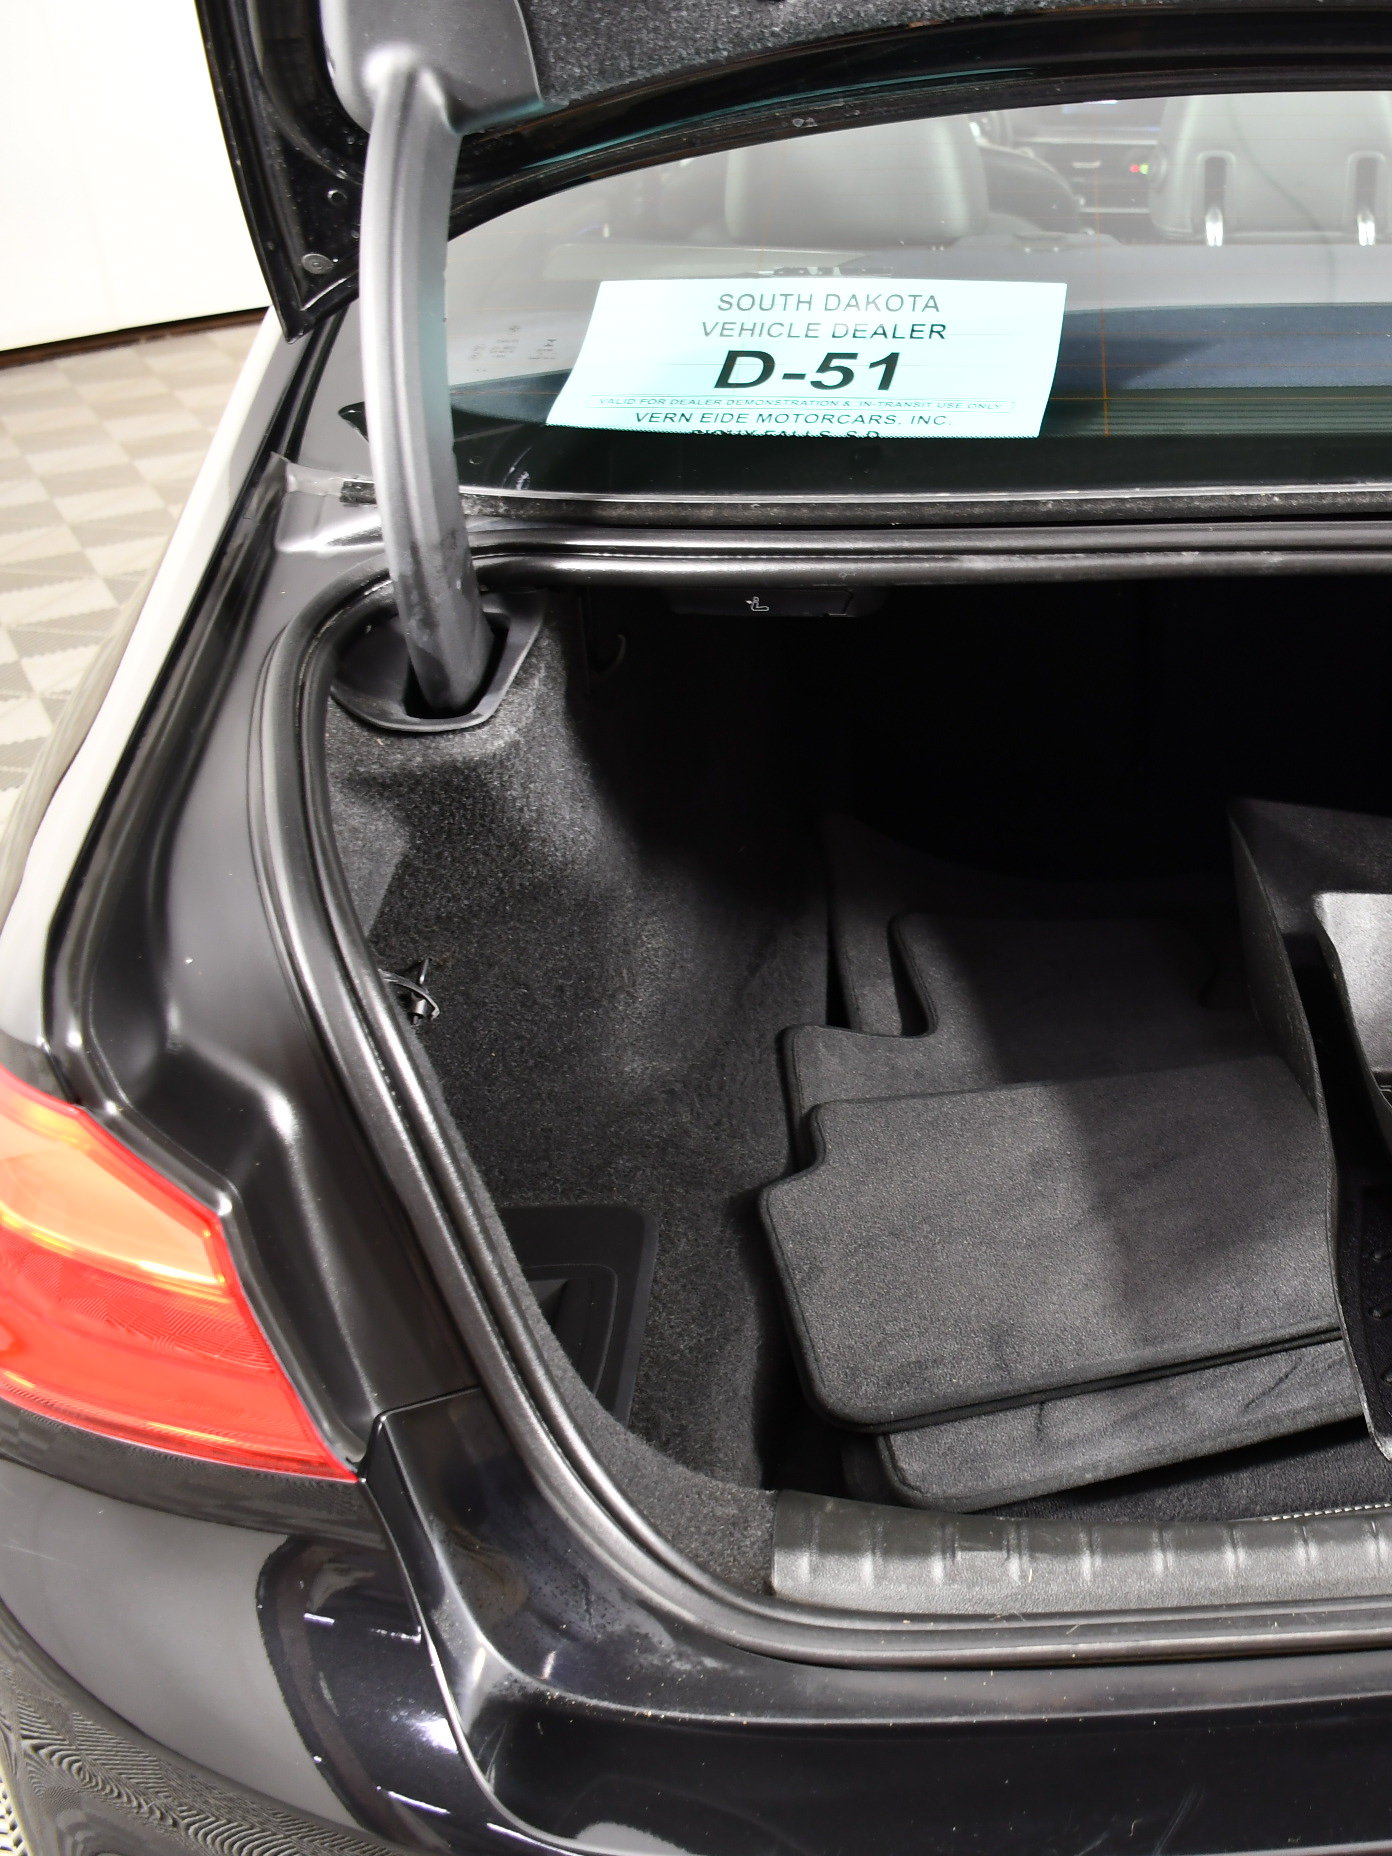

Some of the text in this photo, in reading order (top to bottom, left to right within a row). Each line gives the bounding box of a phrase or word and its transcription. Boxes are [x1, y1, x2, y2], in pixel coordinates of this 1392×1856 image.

[717, 293, 940, 312] SOUTH DAKOTA
[702, 321, 947, 340] VEHICLE DEALER
[714, 350, 900, 391] D-51
[599, 397, 636, 405] VALID
[669, 398, 721, 406] DEALER
[726, 399, 839, 407] DEMONSTRATION
[967, 402, 1003, 410] ONLY
[636, 412, 693, 423] VERN
[700, 412, 750, 424] EIDE
[910, 415, 952, 426] INC.
